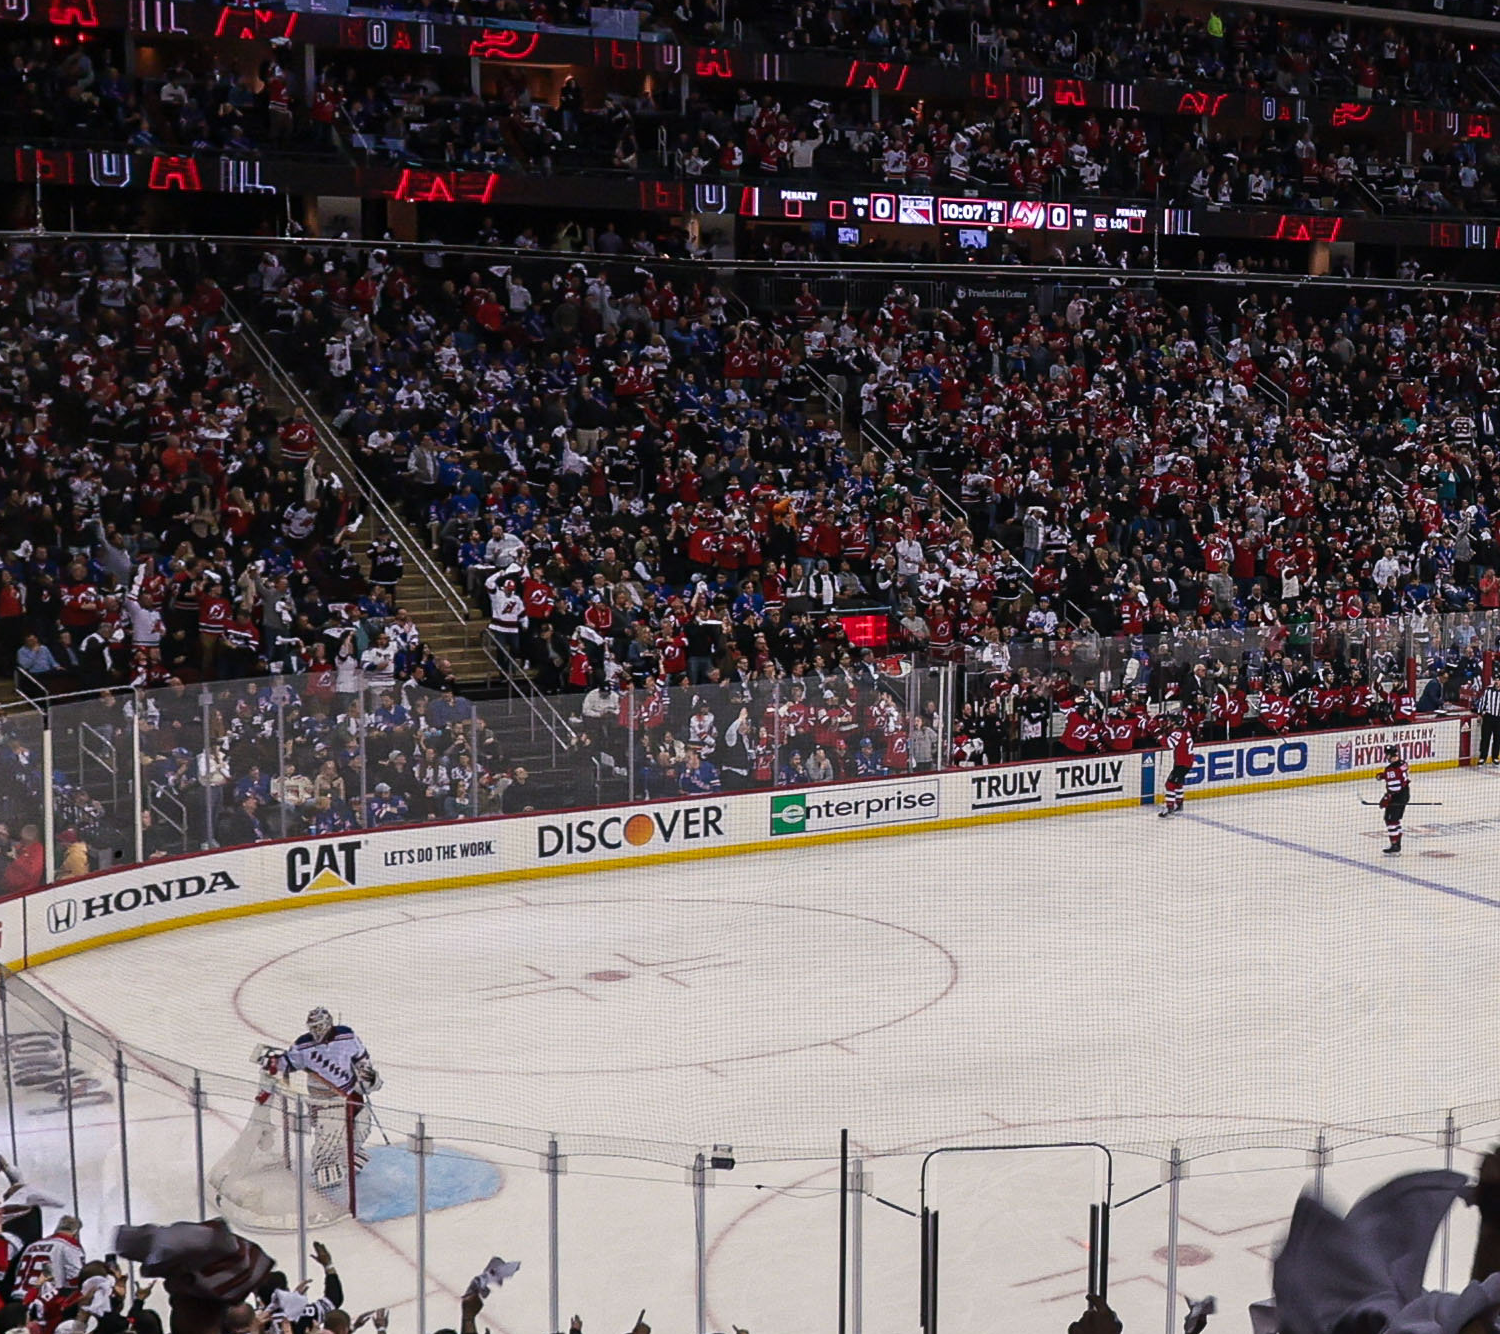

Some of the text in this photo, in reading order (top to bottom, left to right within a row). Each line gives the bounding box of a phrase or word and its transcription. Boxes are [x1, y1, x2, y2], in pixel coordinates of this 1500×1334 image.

[781, 190, 817, 201] PENALTY
[876, 198, 889, 218] 0
[942, 203, 983, 220] 10:07
[991, 211, 999, 222] 2
[1052, 206, 1065, 226] 0
[1116, 208, 1146, 218] PENALTY
[1110, 218, 1128, 229] 1:04
[968, 288, 1028, 299] Prudential Center
[1356, 728, 1436, 746] CLEAN. HEALTHY.
[972, 771, 1041, 799] TRULY
[1056, 762, 1123, 788] TRULY
[779, 790, 936, 824] enterprise
[537, 806, 725, 858] DISCOVER
[385, 852, 415, 866] LET'S
[418, 848, 432, 862] DO
[437, 846, 457, 860] THE
[287, 841, 362, 893] CAT
[82, 870, 241, 921] HONDA
